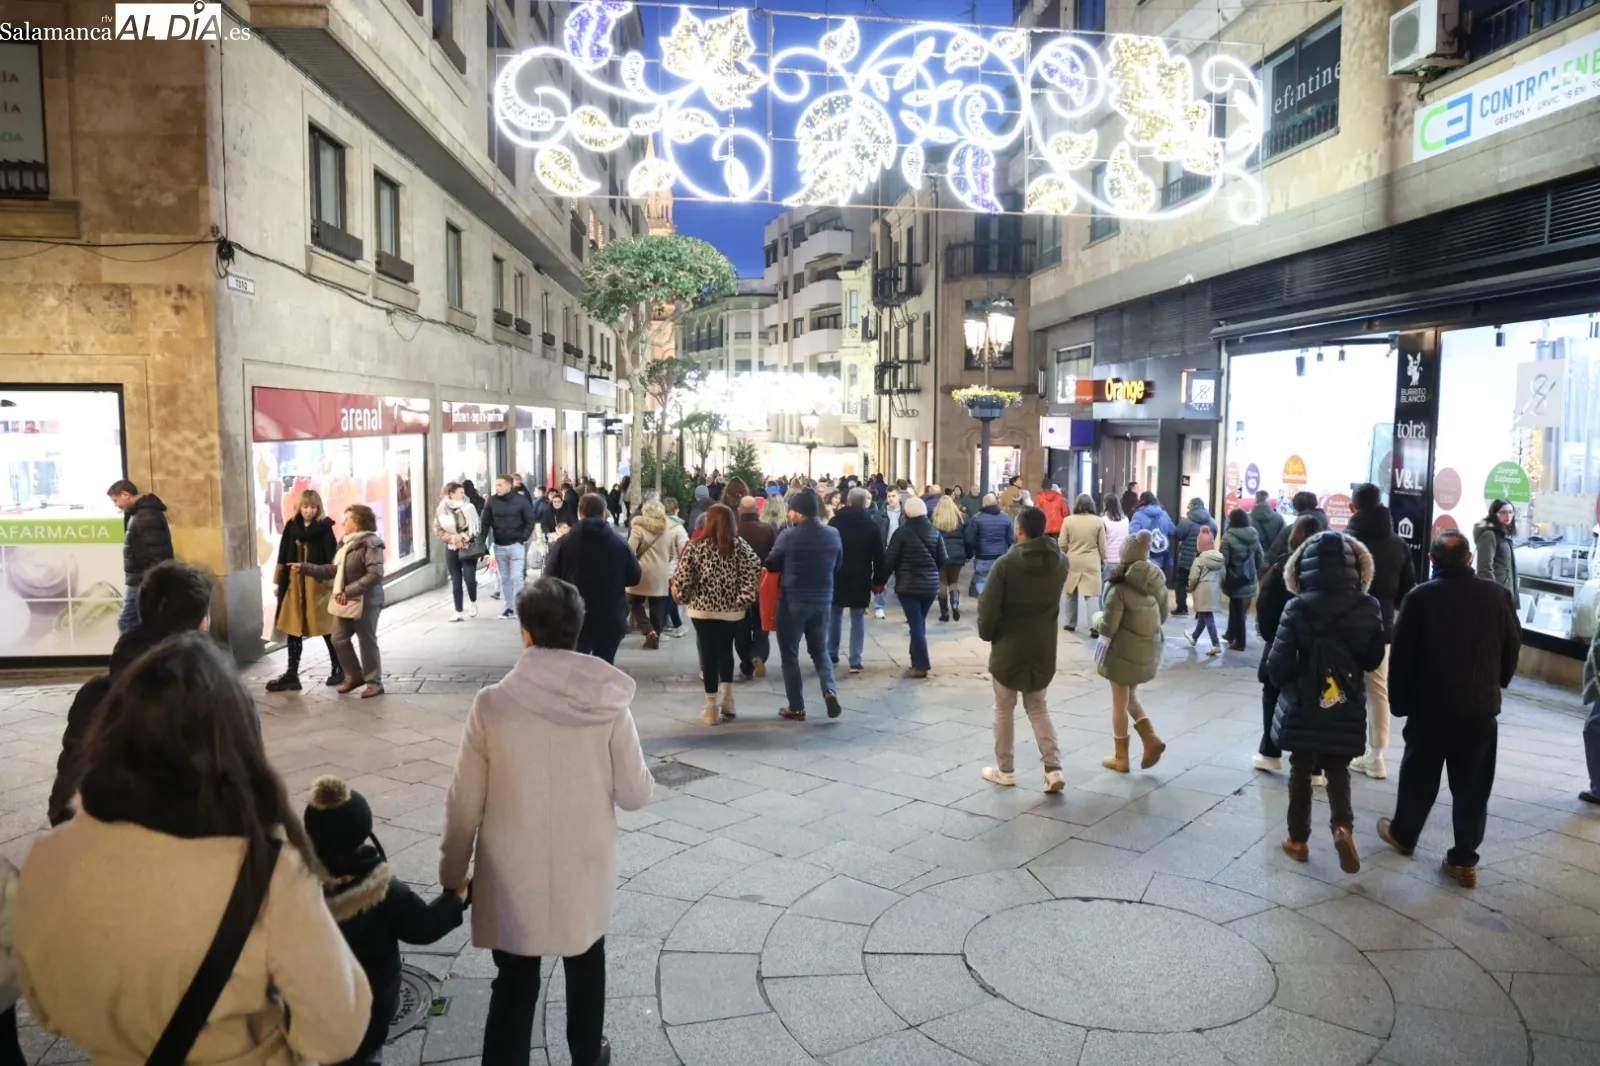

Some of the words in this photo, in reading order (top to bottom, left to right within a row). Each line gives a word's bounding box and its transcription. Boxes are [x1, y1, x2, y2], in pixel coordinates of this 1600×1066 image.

[1105, 377, 1145, 404] Orange
[1400, 387, 1427, 396] BURRITO
[1400, 395, 1426, 403] BLANCO
[341, 405, 382, 432] arenal
[1395, 468, 1423, 490] V&L
